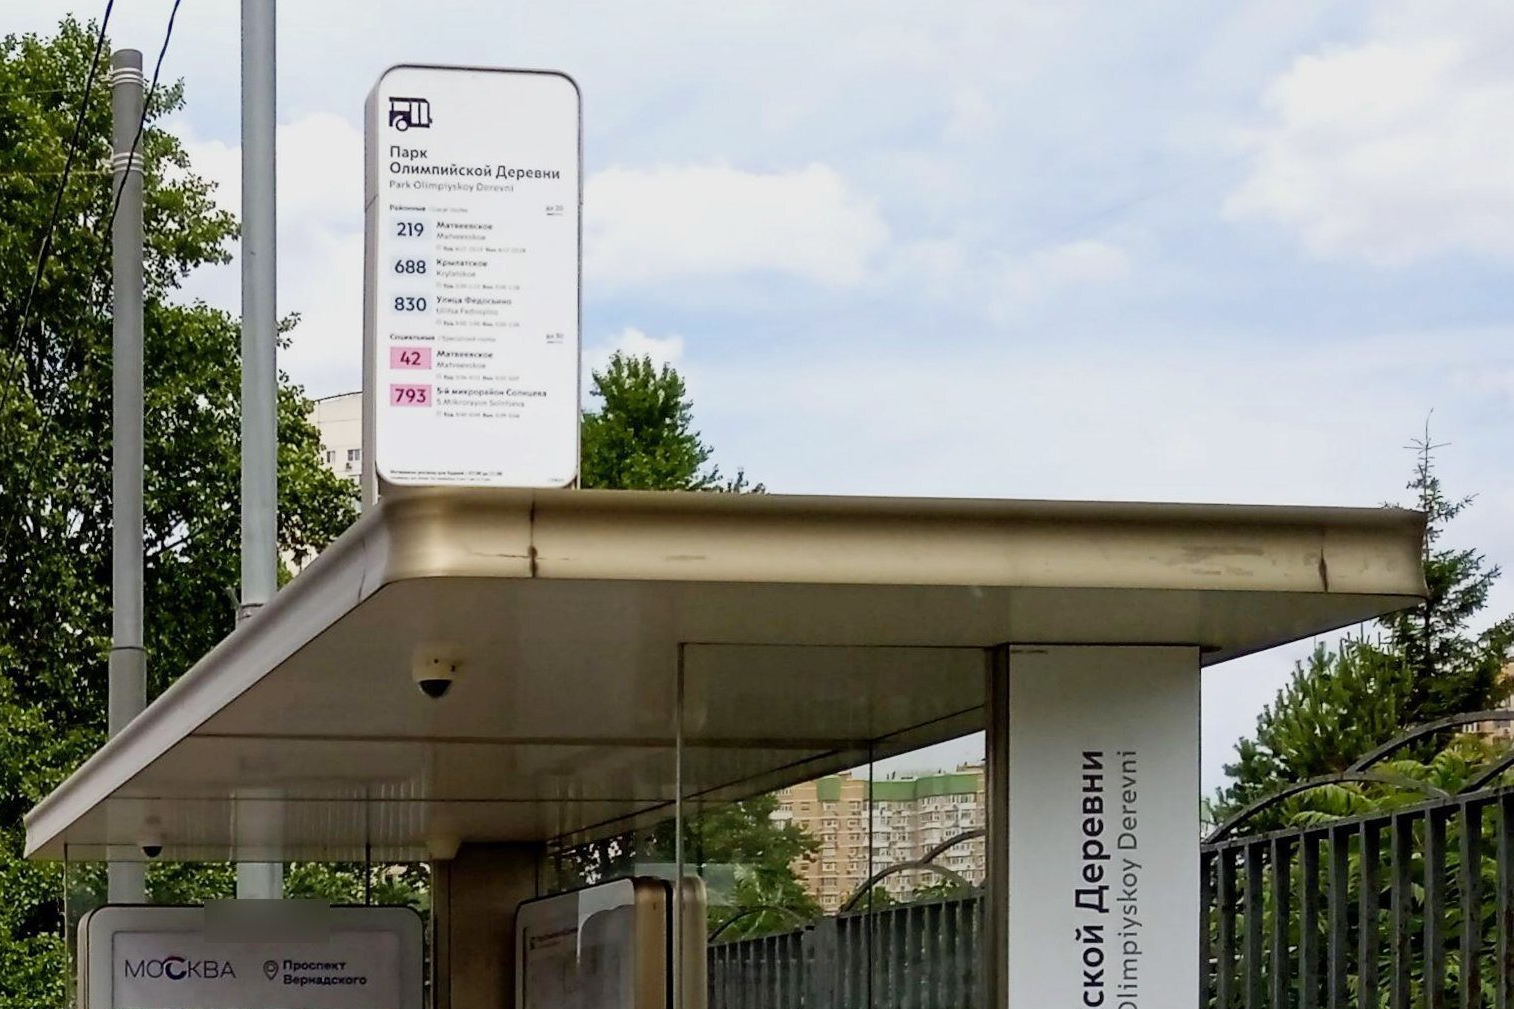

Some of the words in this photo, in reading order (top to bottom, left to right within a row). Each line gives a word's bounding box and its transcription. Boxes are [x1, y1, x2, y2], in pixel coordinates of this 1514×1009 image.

[390, 146, 427, 160] Парк
[390, 162, 491, 177] Олимпийской
[496, 166, 560, 180] Деревни
[390, 180, 410, 189] Park
[397, 222, 424, 236] 219
[395, 260, 426, 274] 688
[394, 297, 426, 311] 830
[400, 352, 421, 365] 42
[395, 389, 426, 403] 793
[1118, 750, 1138, 849] Derevni
[1075, 750, 1111, 913] Деревни
[125, 956, 236, 980] МОСКВА
[284, 960, 345, 973] Проспект
[284, 975, 366, 987] Вернадского
